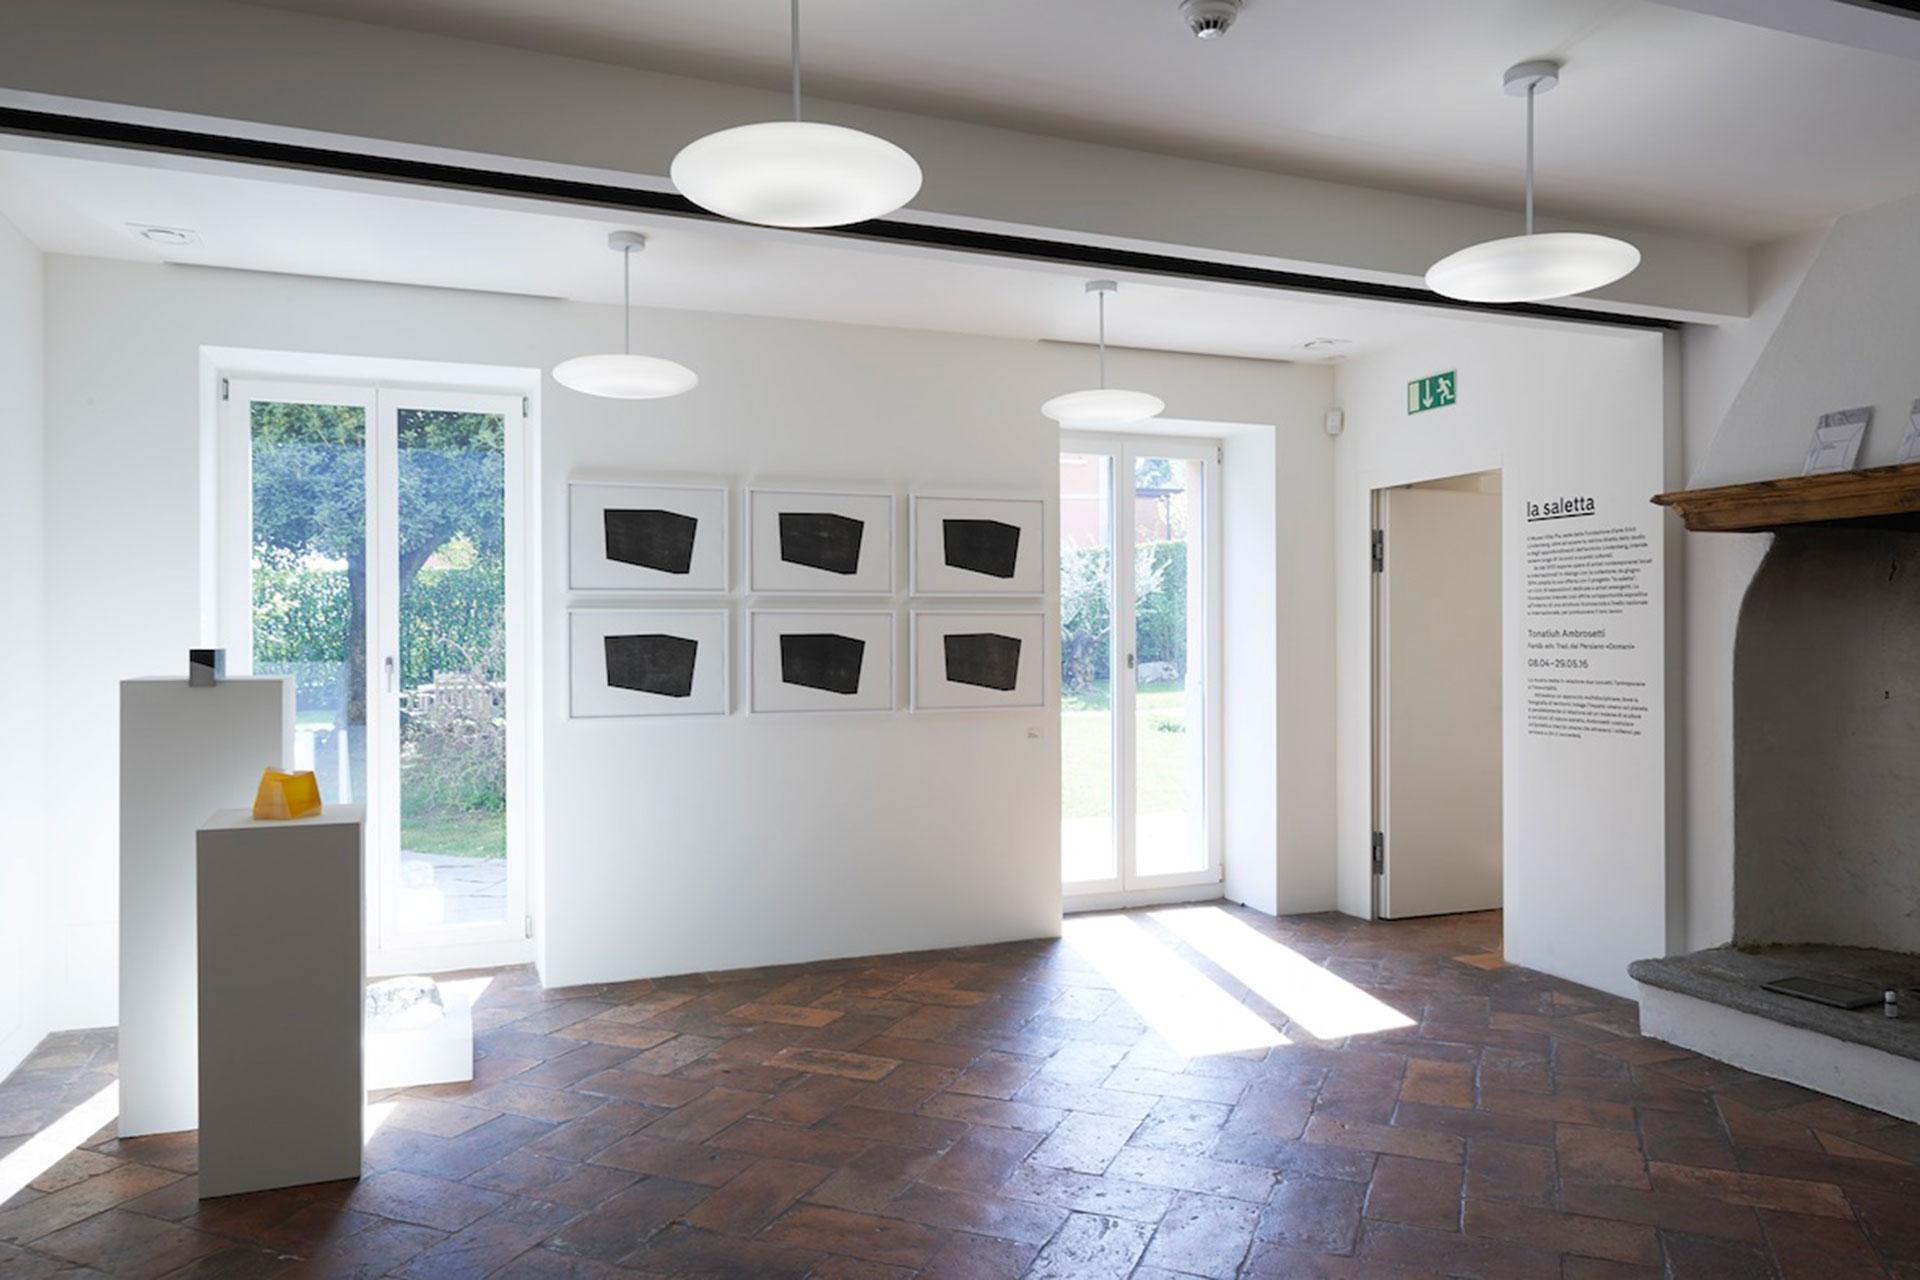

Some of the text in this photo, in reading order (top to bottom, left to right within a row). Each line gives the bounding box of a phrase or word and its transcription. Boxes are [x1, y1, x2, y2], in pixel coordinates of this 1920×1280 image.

[1527, 496, 1595, 517] la saletta
[1562, 629, 1606, 638] Ambrosetti
